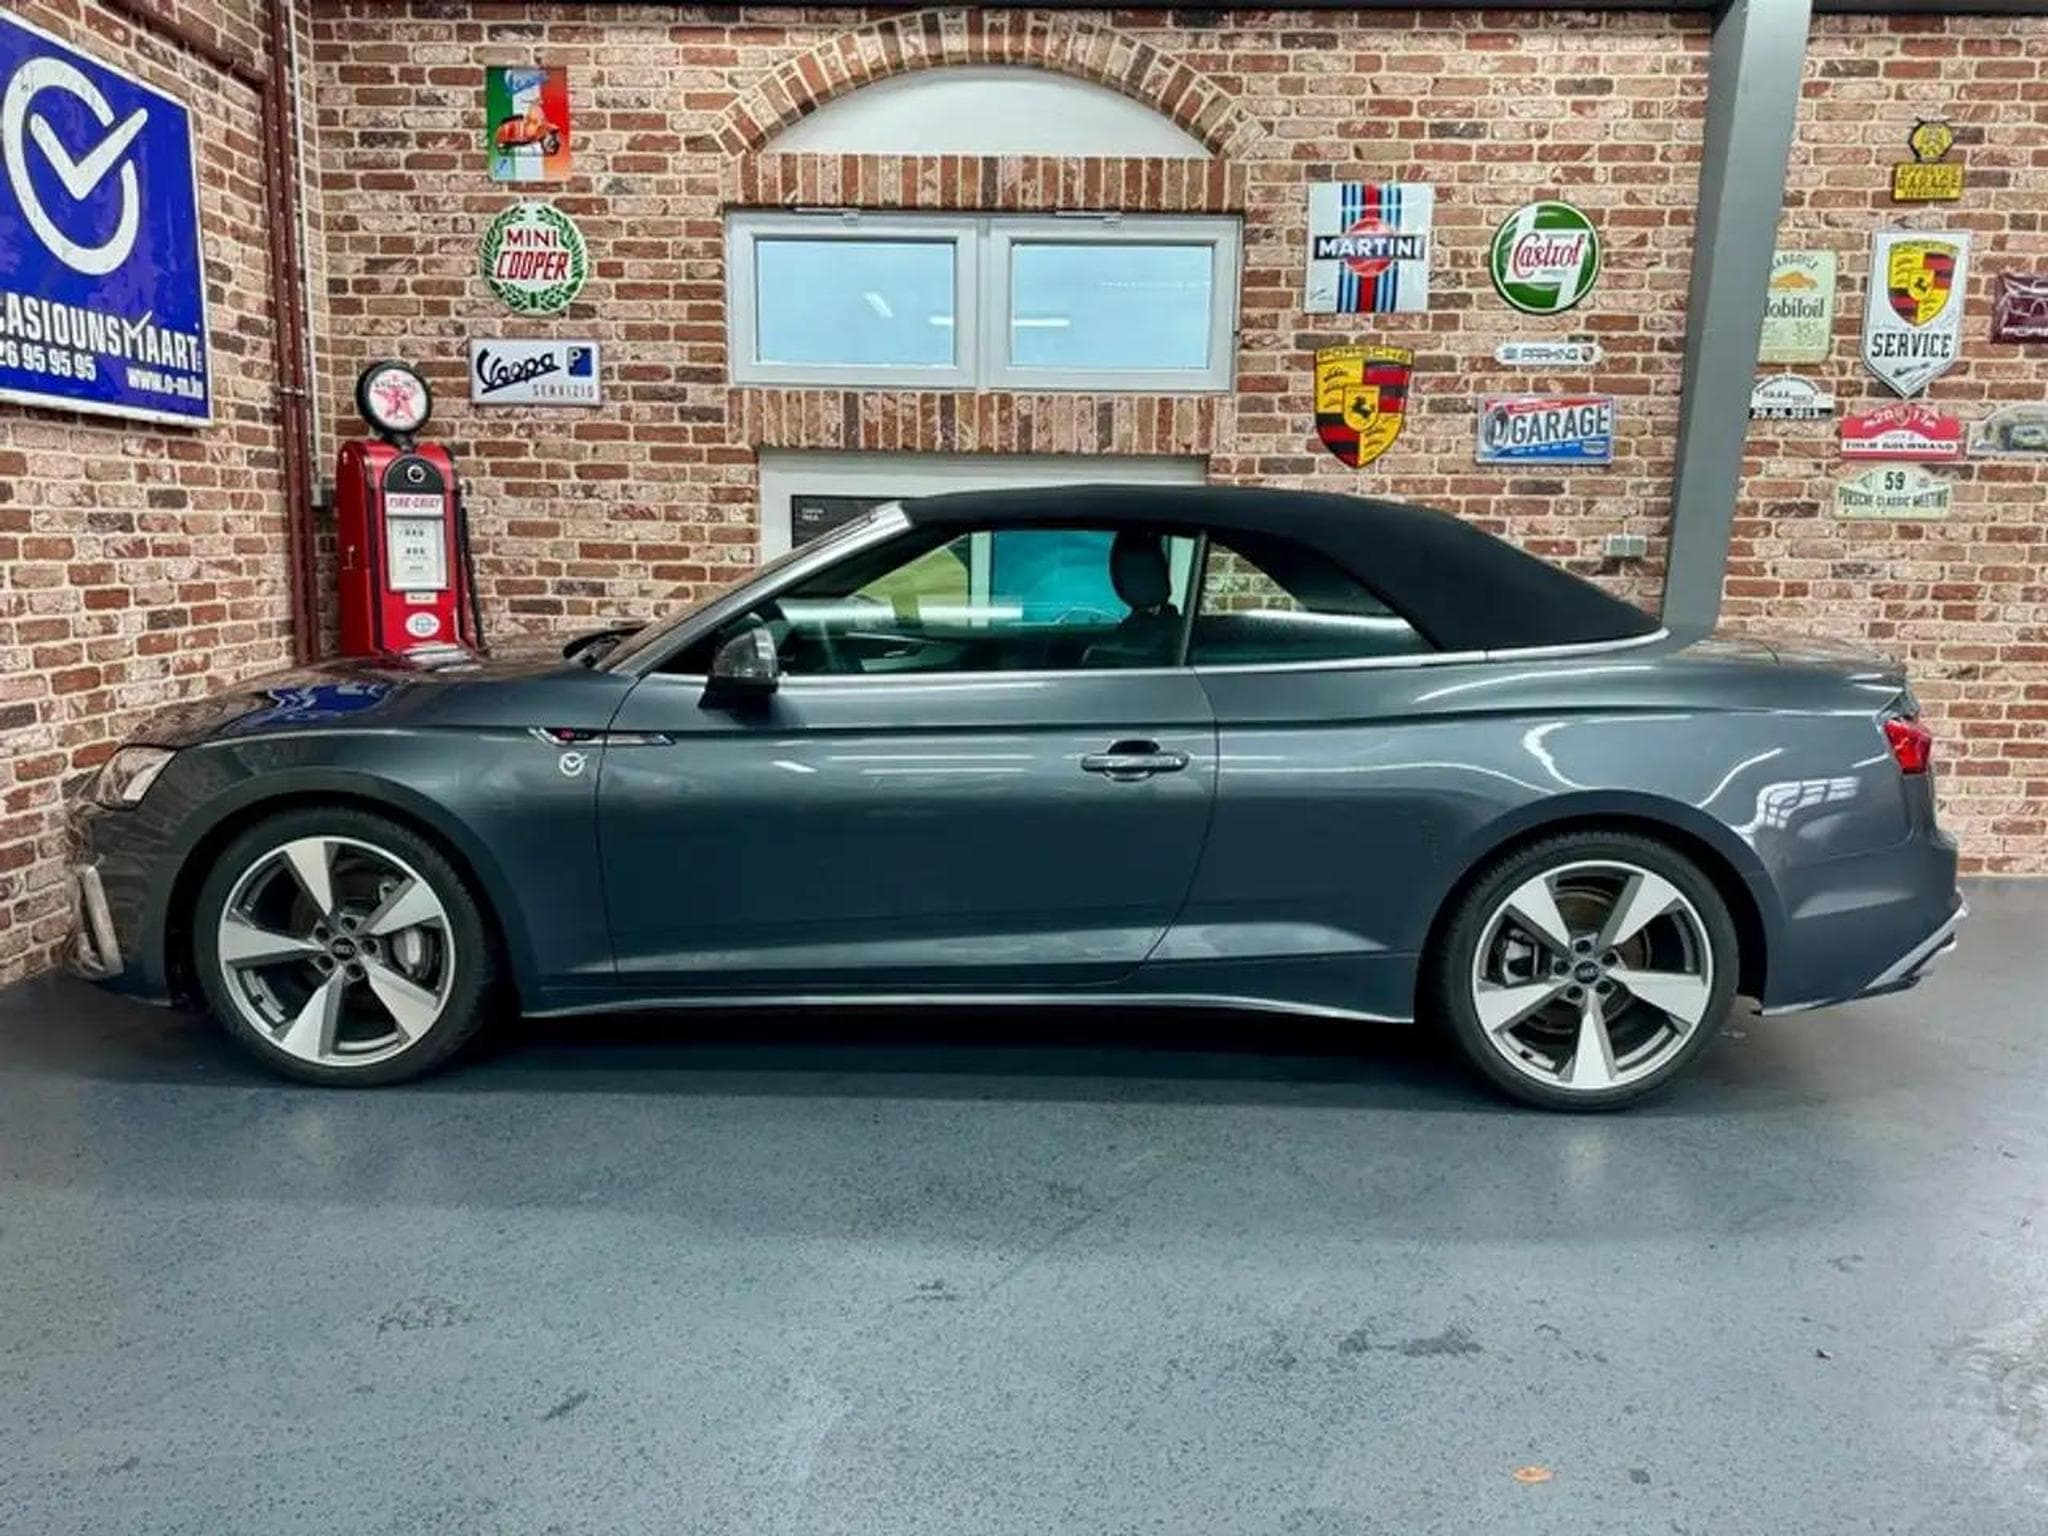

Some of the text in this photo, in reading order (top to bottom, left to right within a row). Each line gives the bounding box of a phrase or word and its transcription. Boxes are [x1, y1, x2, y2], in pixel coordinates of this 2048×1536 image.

[507, 228, 557, 247] MINI
[1318, 238, 1421, 257] MARTINI
[496, 250, 570, 281] COOPER
[1513, 232, 1585, 279] Castrol
[0, 291, 198, 373] ASIOUNSMAART
[1871, 332, 1953, 358] SERVICE
[22, 342, 47, 373] 95
[49, 348, 72, 377] 95
[74, 353, 97, 381] 95
[476, 348, 561, 395] Vespa
[533, 383, 595, 398] SERVIZIO
[1511, 404, 1609, 445] GARAGE
[1884, 471, 1906, 491] 59
